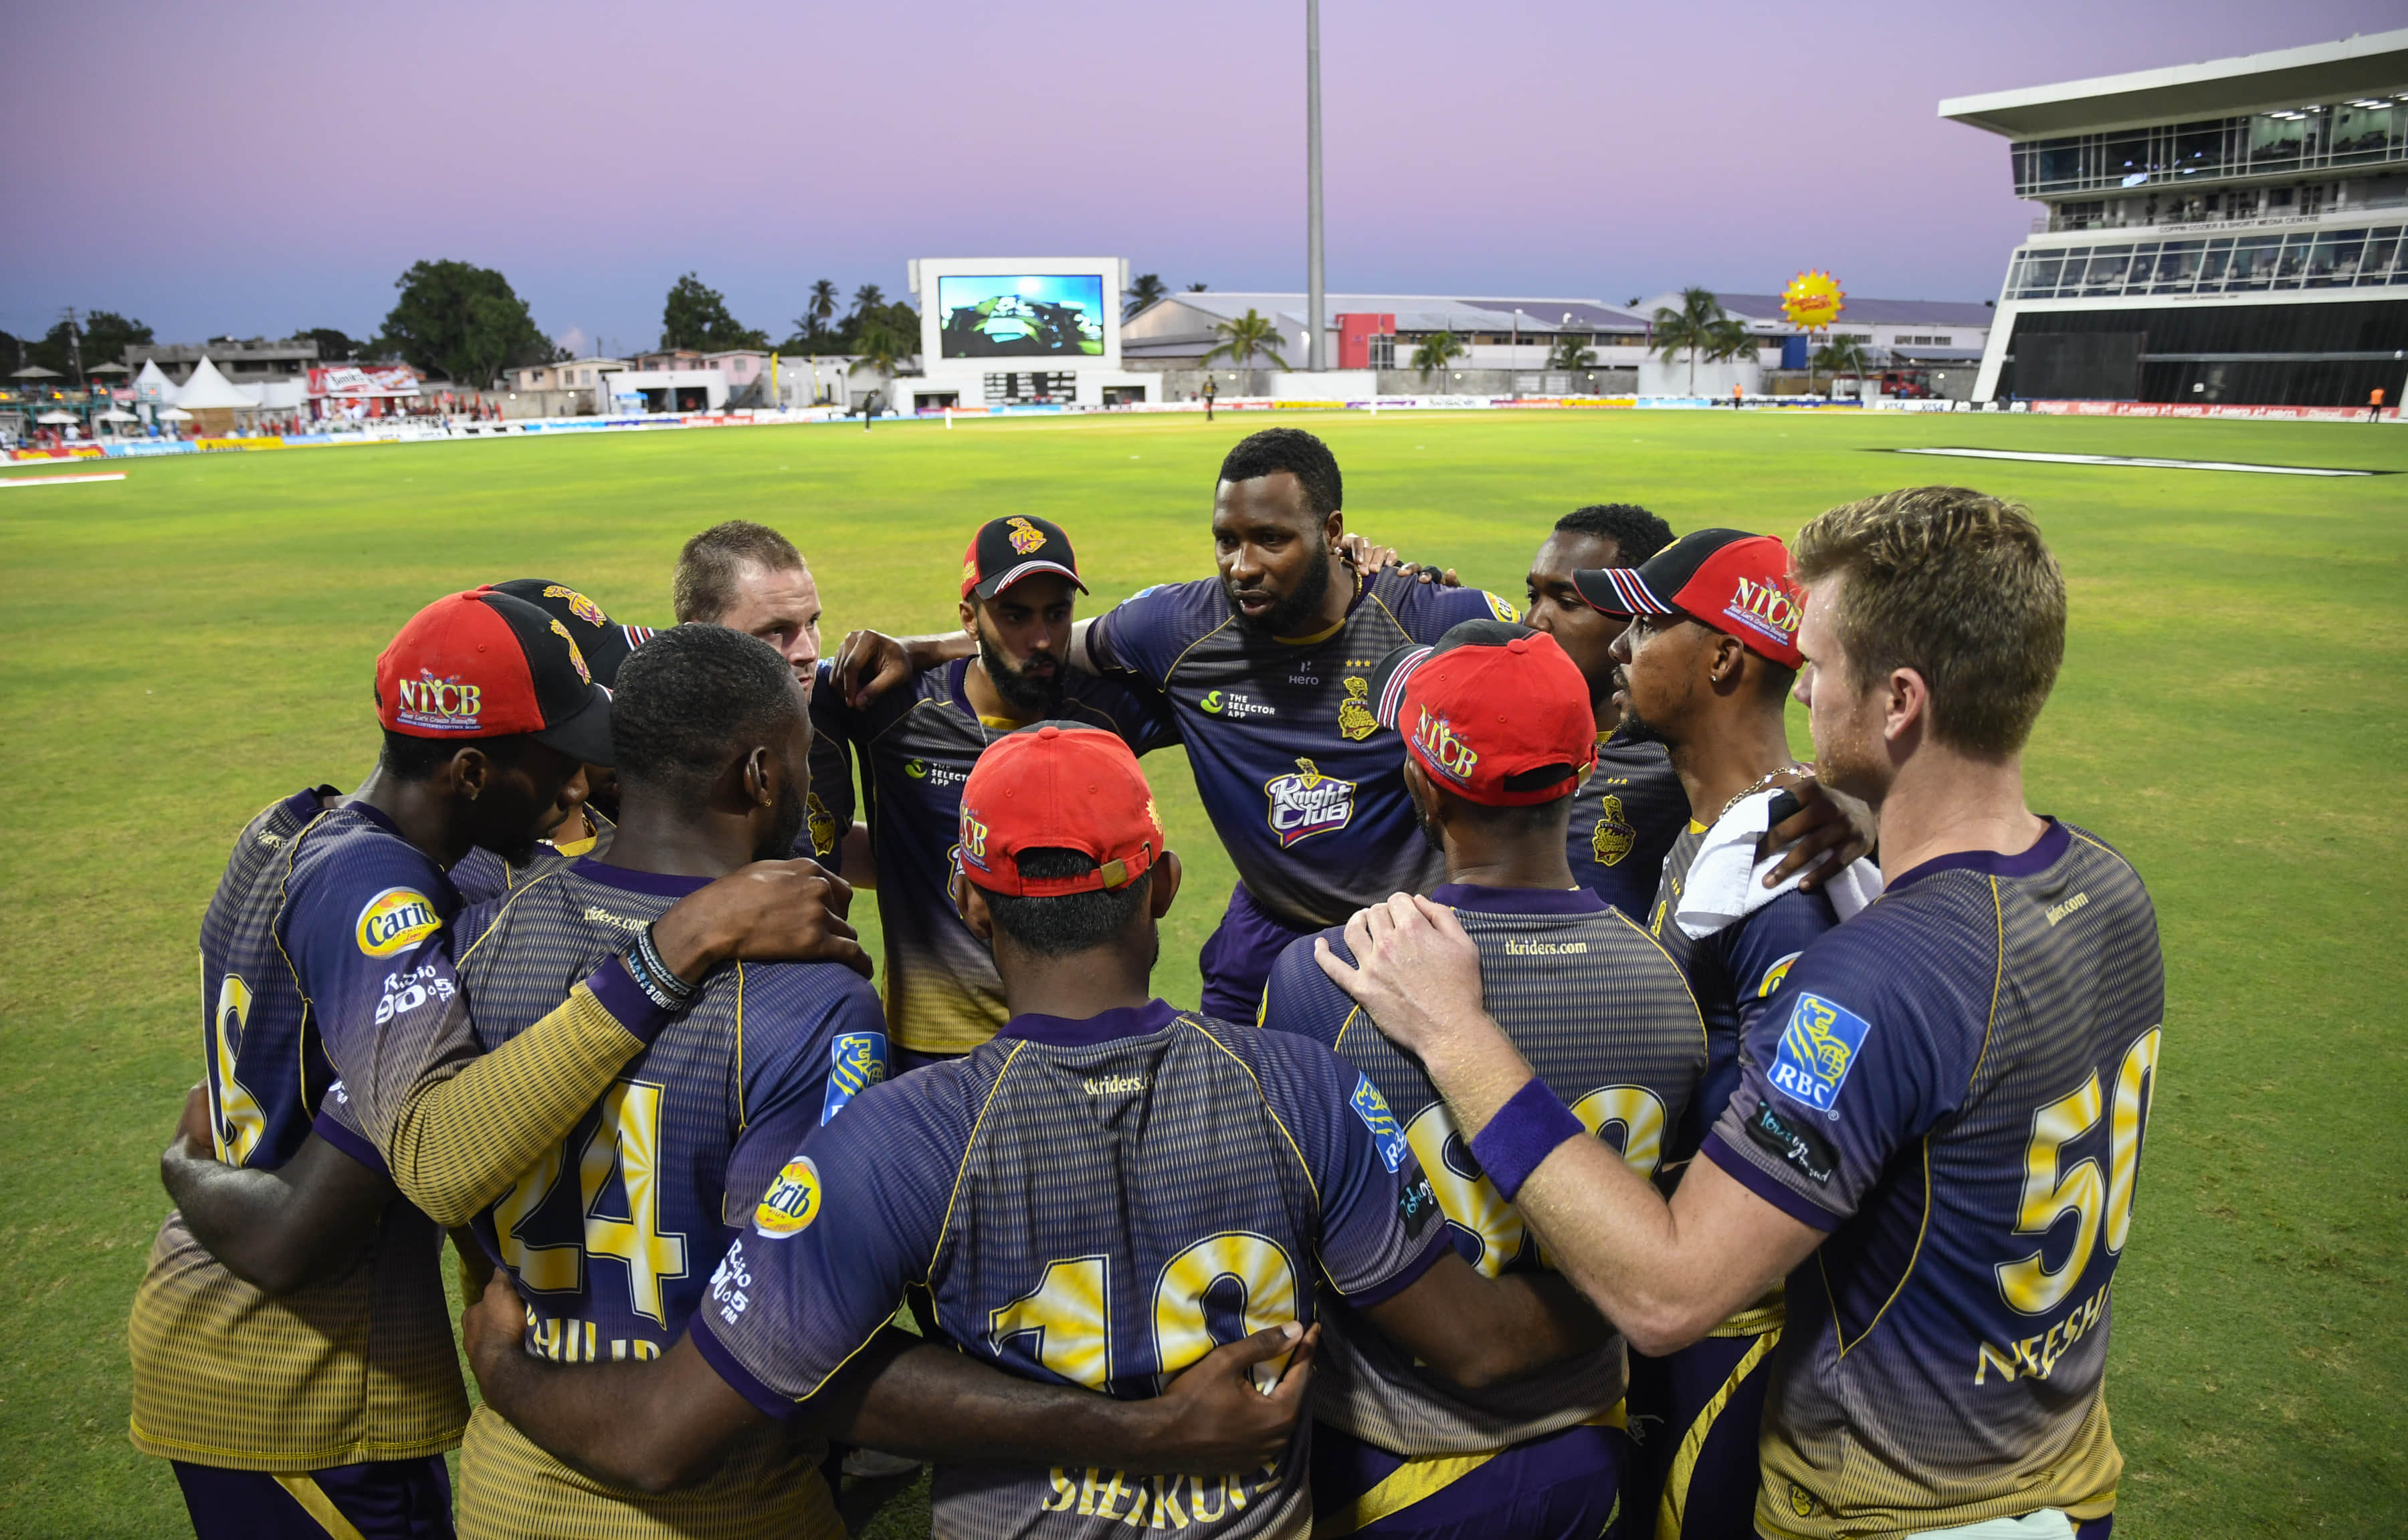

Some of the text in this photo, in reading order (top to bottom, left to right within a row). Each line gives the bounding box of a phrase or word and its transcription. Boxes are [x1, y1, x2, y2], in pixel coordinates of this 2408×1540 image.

[2285, 216, 2320, 224] CENTRE
[1289, 675, 1318, 685] Hero
[398, 678, 481, 718] NLCB
[1228, 702, 1275, 715] SELECTOR
[1229, 693, 1247, 703] THE
[1227, 711, 1245, 719] APP
[1415, 703, 1478, 778] NLCB
[930, 778, 949, 786] APP
[1270, 778, 1351, 810] Knight
[366, 901, 436, 948] Carib
[584, 906, 649, 931] riders.com
[1505, 940, 1587, 956] tkriders.com
[1775, 1063, 1830, 1105] RBC
[1386, 1131, 1405, 1167] RB
[1994, 1024, 2161, 1315] 50
[493, 1077, 689, 1331] 24
[720, 1305, 738, 1325] FM
[1975, 1283, 2107, 1385] NEESH
